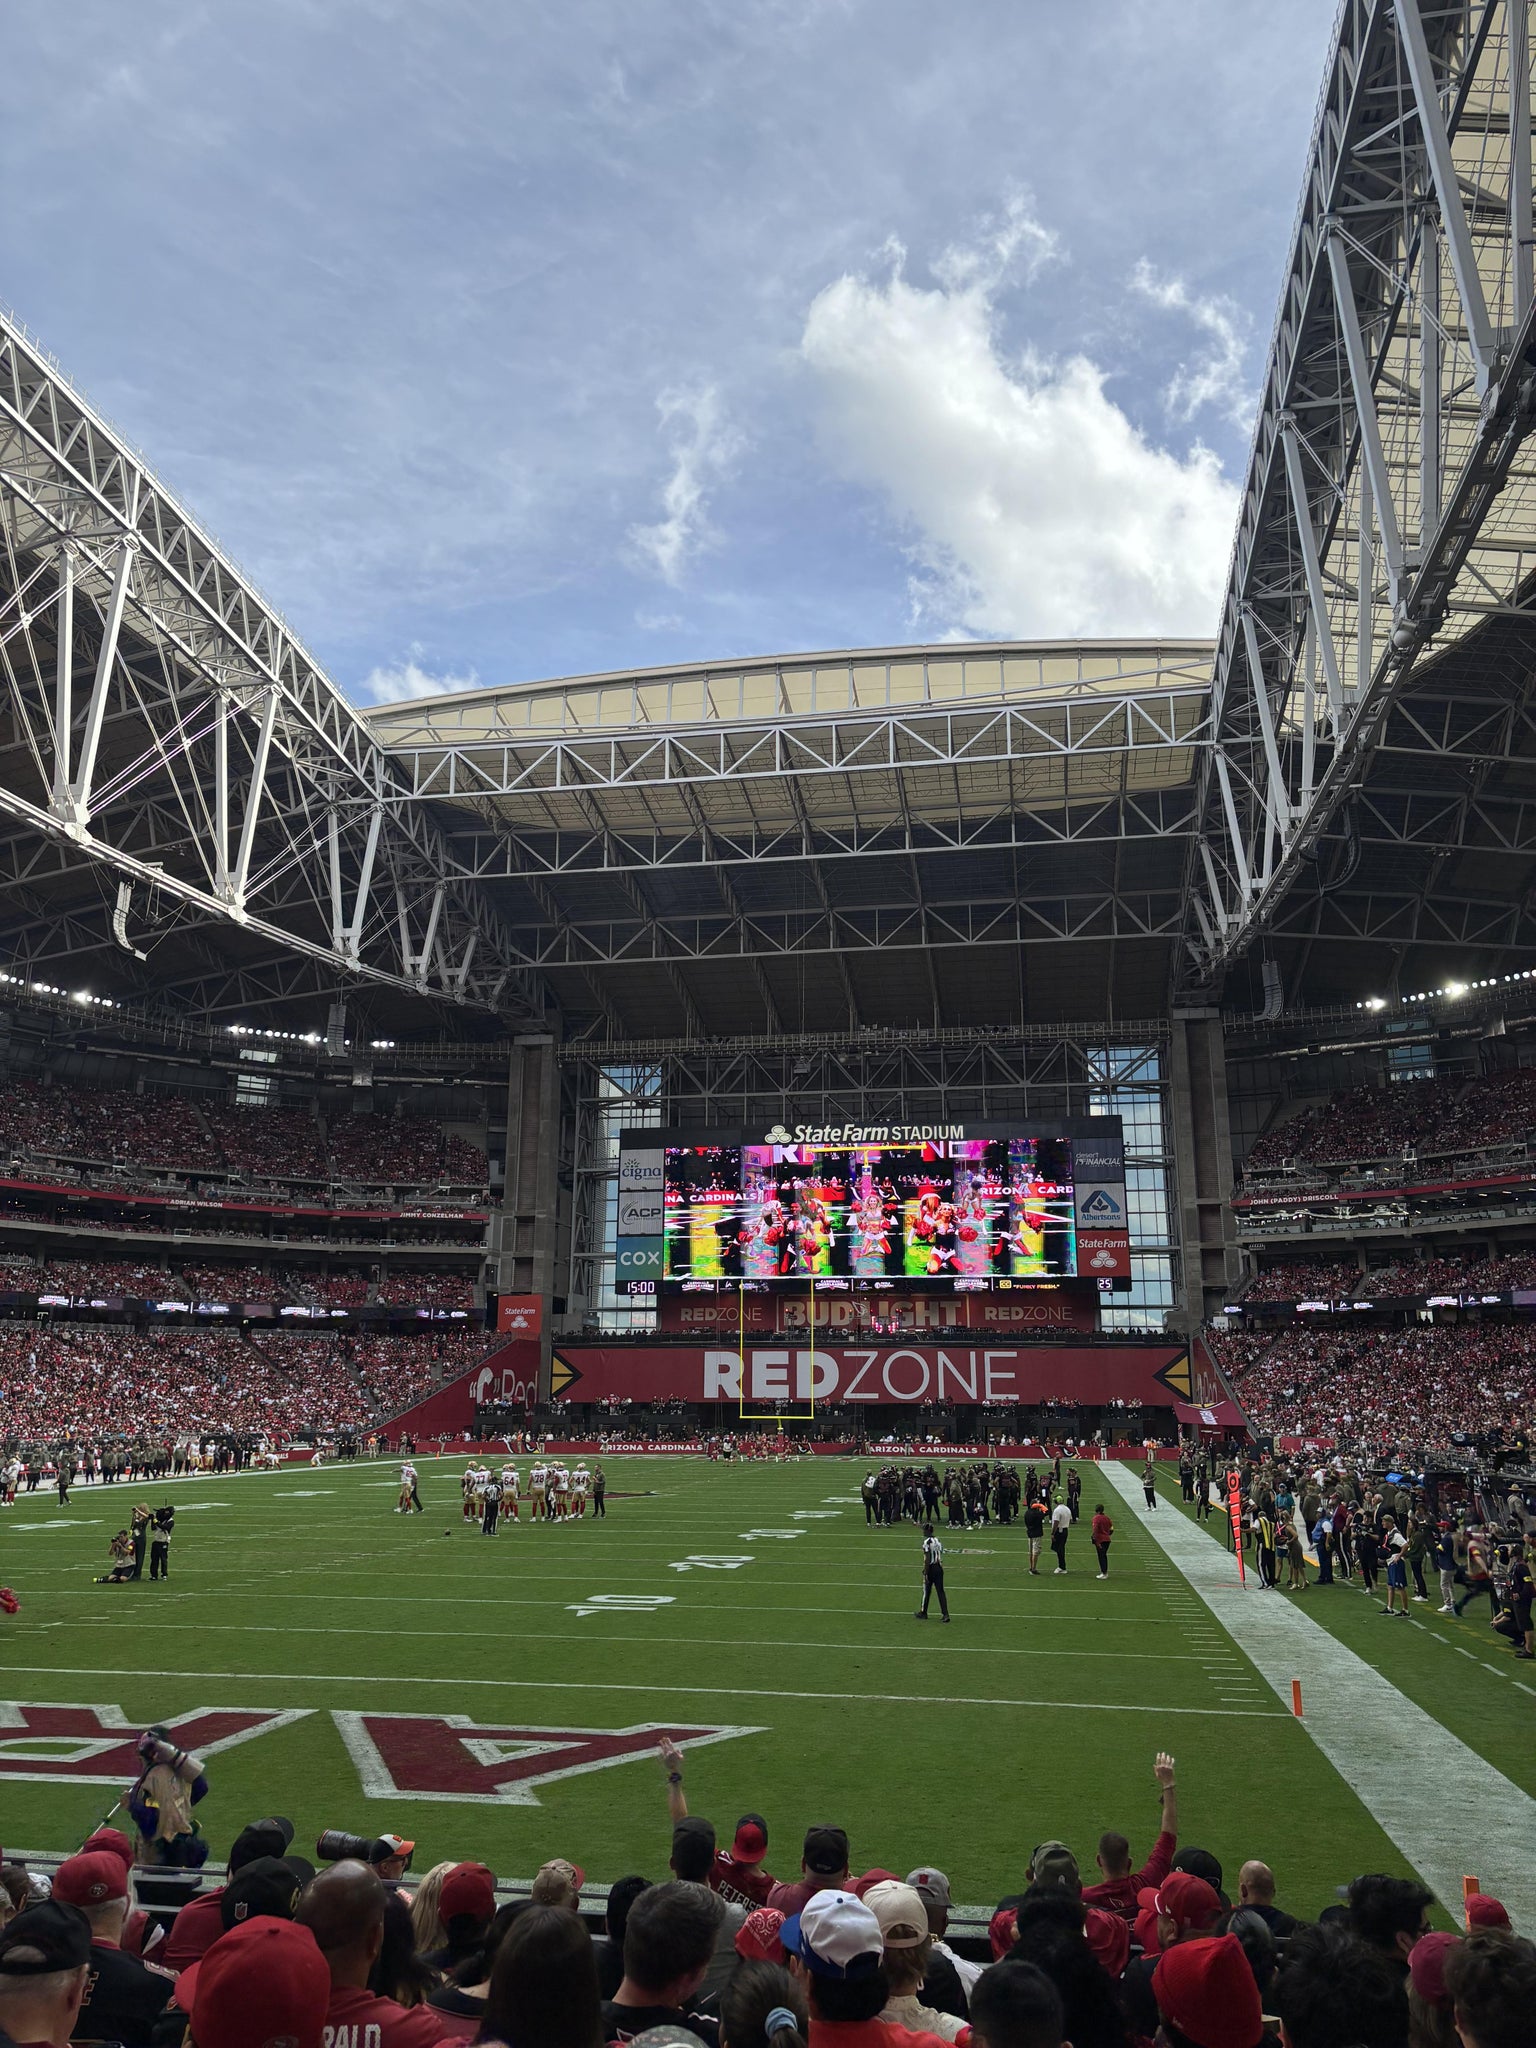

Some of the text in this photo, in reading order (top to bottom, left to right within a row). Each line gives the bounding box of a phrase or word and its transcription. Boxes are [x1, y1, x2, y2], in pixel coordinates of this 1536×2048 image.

[892, 1125, 964, 1140] STADIUM
[622, 1167, 662, 1180] cigna
[981, 1187, 1031, 1195] RIZONA
[170, 1199, 196, 1207] ADRIAN
[690, 1193, 757, 1202] CARDINALS
[1303, 1194, 1339, 1202] DRISCOLL
[627, 1208, 662, 1217] ACP
[1082, 1213, 1121, 1221] Albertsons
[620, 1251, 660, 1266] COX
[627, 1281, 655, 1294] 15:00
[1098, 1279, 1111, 1289] 25
[784, 1301, 855, 1326] BUD
[984, 1306, 1073, 1321] REDZONE
[703, 1350, 1020, 1400] REDZONE
[919, 1446, 978, 1454] CARDINALS
[535, 1474, 545, 1483] 78
[575, 1476, 585, 1485] 44
[667, 1555, 756, 1572] 20
[563, 1594, 678, 1617] 10
[717, 1880, 764, 1914] PETERS
